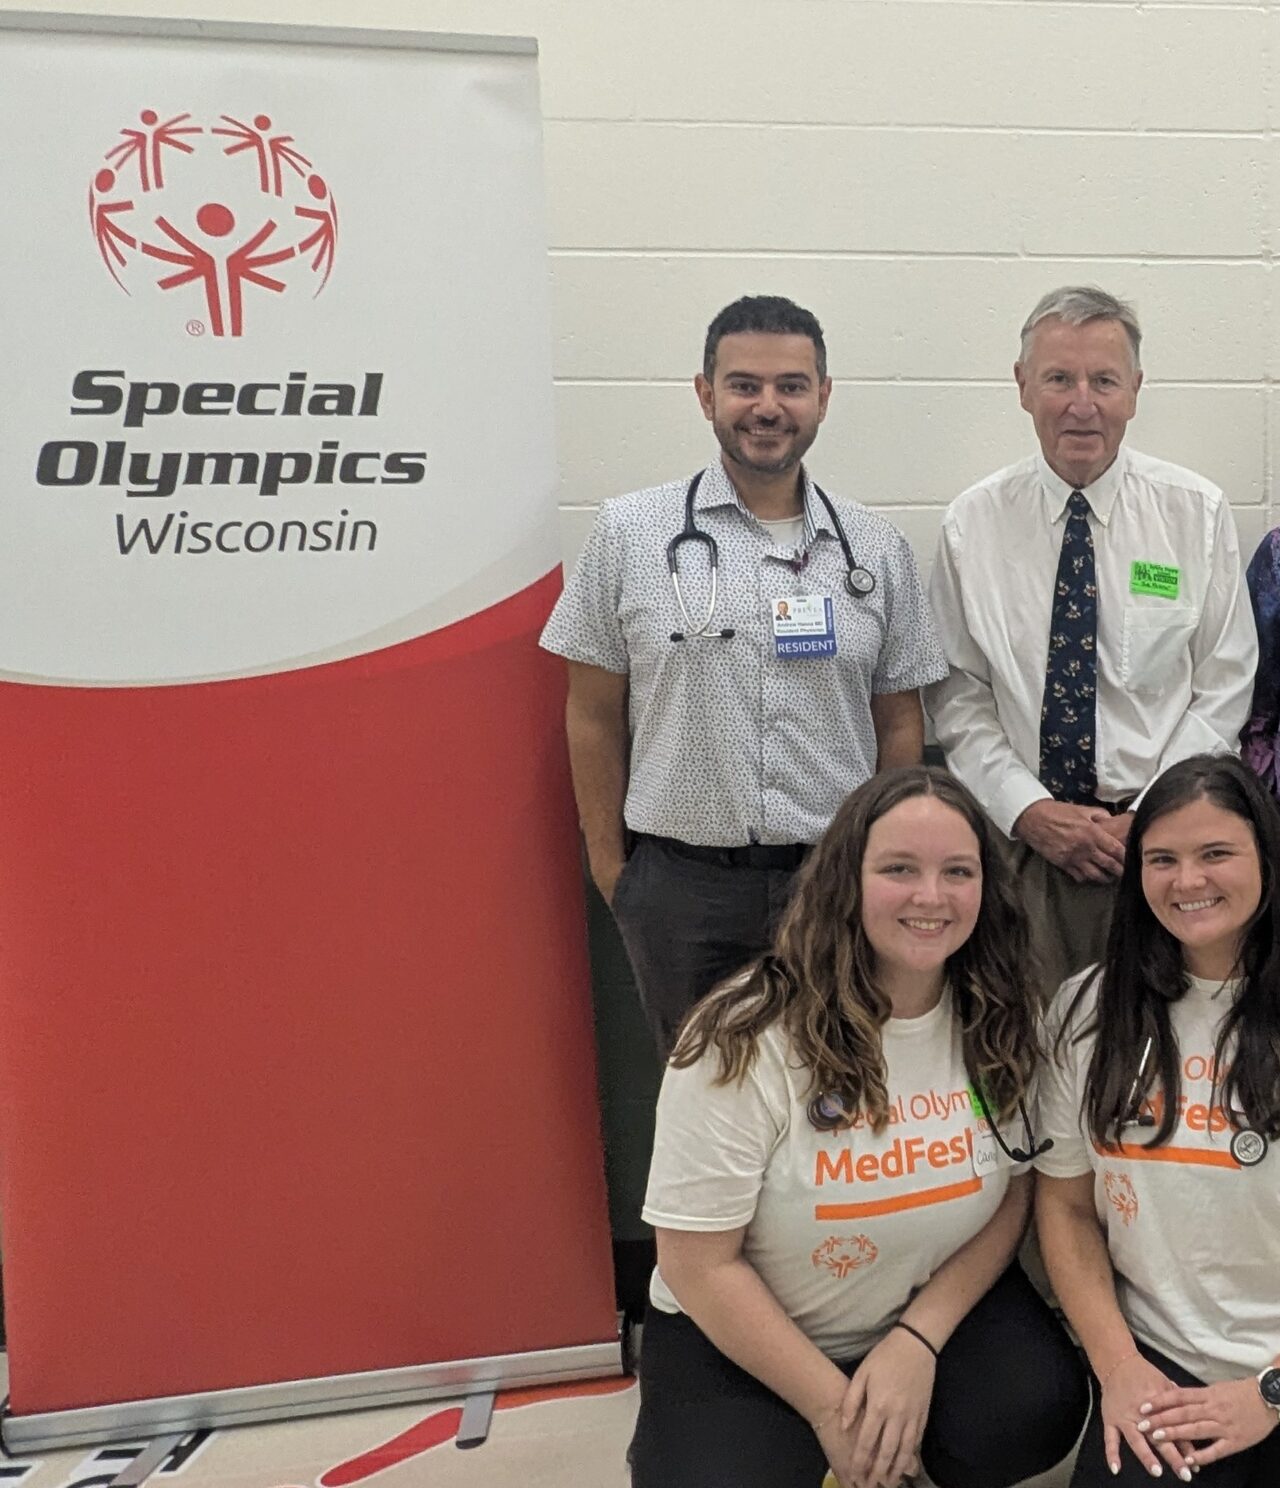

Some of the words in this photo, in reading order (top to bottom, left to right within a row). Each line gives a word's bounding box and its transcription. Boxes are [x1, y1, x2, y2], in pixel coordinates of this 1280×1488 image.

[71, 370, 384, 427] Special
[36, 440, 428, 498] Olympics
[115, 509, 378, 555] Wisconsin
[777, 640, 835, 653] RESIDENT
